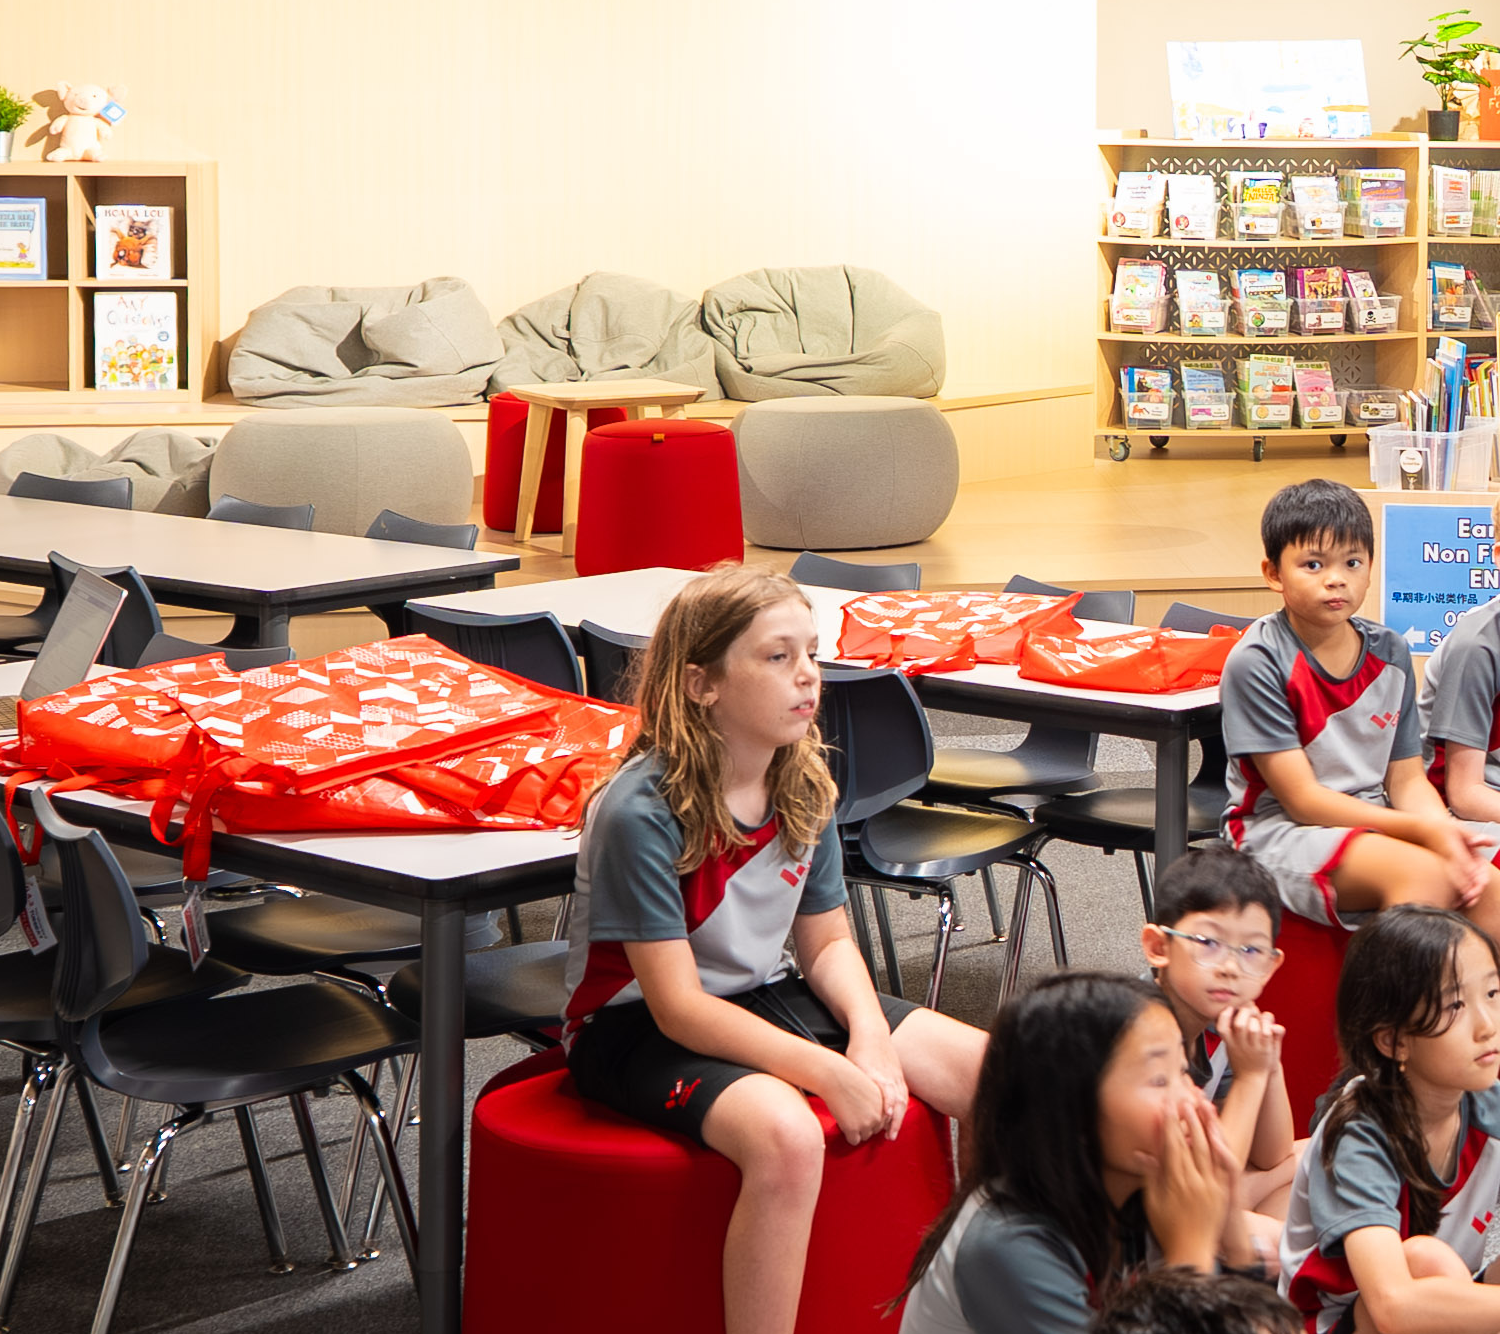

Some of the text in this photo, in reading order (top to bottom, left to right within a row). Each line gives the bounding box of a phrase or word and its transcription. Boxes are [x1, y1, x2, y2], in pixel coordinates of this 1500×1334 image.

[1248, 193, 1275, 201] NINJA
[104, 209, 164, 217] KOALA LOU
[1423, 542, 1470, 564] Non
[1392, 591, 1478, 605] 早期非小说类作品
